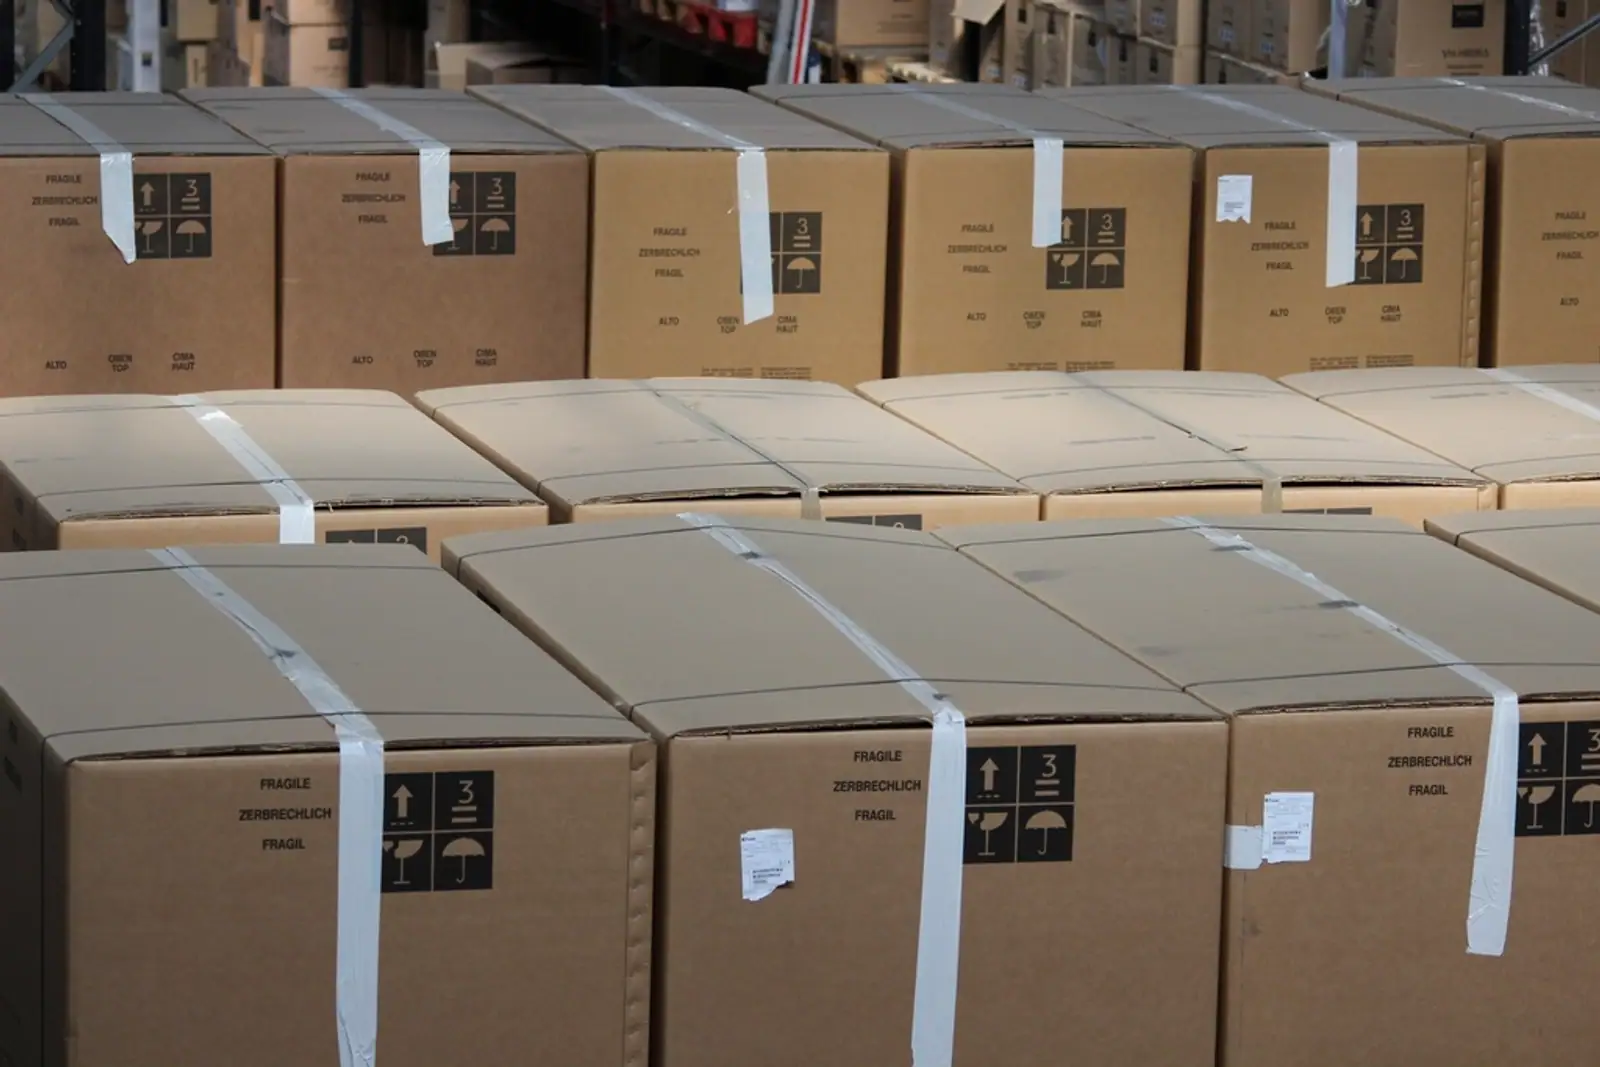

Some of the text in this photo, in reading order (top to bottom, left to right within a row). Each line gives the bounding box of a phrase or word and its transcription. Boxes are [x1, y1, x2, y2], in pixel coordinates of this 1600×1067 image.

[45, 174, 82, 184] FRAGILE
[355, 172, 390, 182] FRAGILE
[186, 179, 198, 197] 3
[491, 177, 503, 196] 3
[358, 214, 388, 224] FRAGIL
[1400, 209, 1412, 226] 3
[1555, 211, 1586, 220] FRAGILE
[48, 217, 80, 227] FRAGIL
[797, 217, 809, 235] 3
[1101, 213, 1113, 230] 3
[1264, 221, 1296, 230] FRAGILE
[653, 227, 687, 237] FRAGILE
[961, 223, 994, 233] FRAGILE
[1556, 250, 1583, 260] FRAGIL
[962, 264, 991, 274] FRAGIL
[1265, 261, 1294, 270] FRAGIL
[654, 268, 684, 278] FRAGIL
[1559, 297, 1580, 306] ALTO
[966, 312, 987, 321] ALTO
[1269, 308, 1290, 318] ALTO
[658, 316, 680, 326] ALTO
[1025, 319, 1042, 330] TOP
[1327, 315, 1343, 325] TOP
[719, 325, 737, 335] TOP
[45, 360, 68, 370] ALTO
[351, 355, 374, 365] ALTO
[416, 358, 434, 368] TOP
[111, 363, 130, 373] TOP
[1407, 726, 1454, 739] FRAGILE
[853, 750, 902, 763] FRAGILE
[1387, 754, 1473, 769] ZERBRECHLICH
[1042, 754, 1057, 776] 3
[259, 777, 311, 791] FRAGILE
[832, 779, 922, 793] ZERBRECHLICH
[457, 779, 475, 805] 3
[1408, 784, 1449, 797] FRAGIL
[238, 807, 332, 822] ZERBRECHLICH
[854, 809, 897, 821] FRAGIL
[262, 837, 306, 851] FRAGIL
